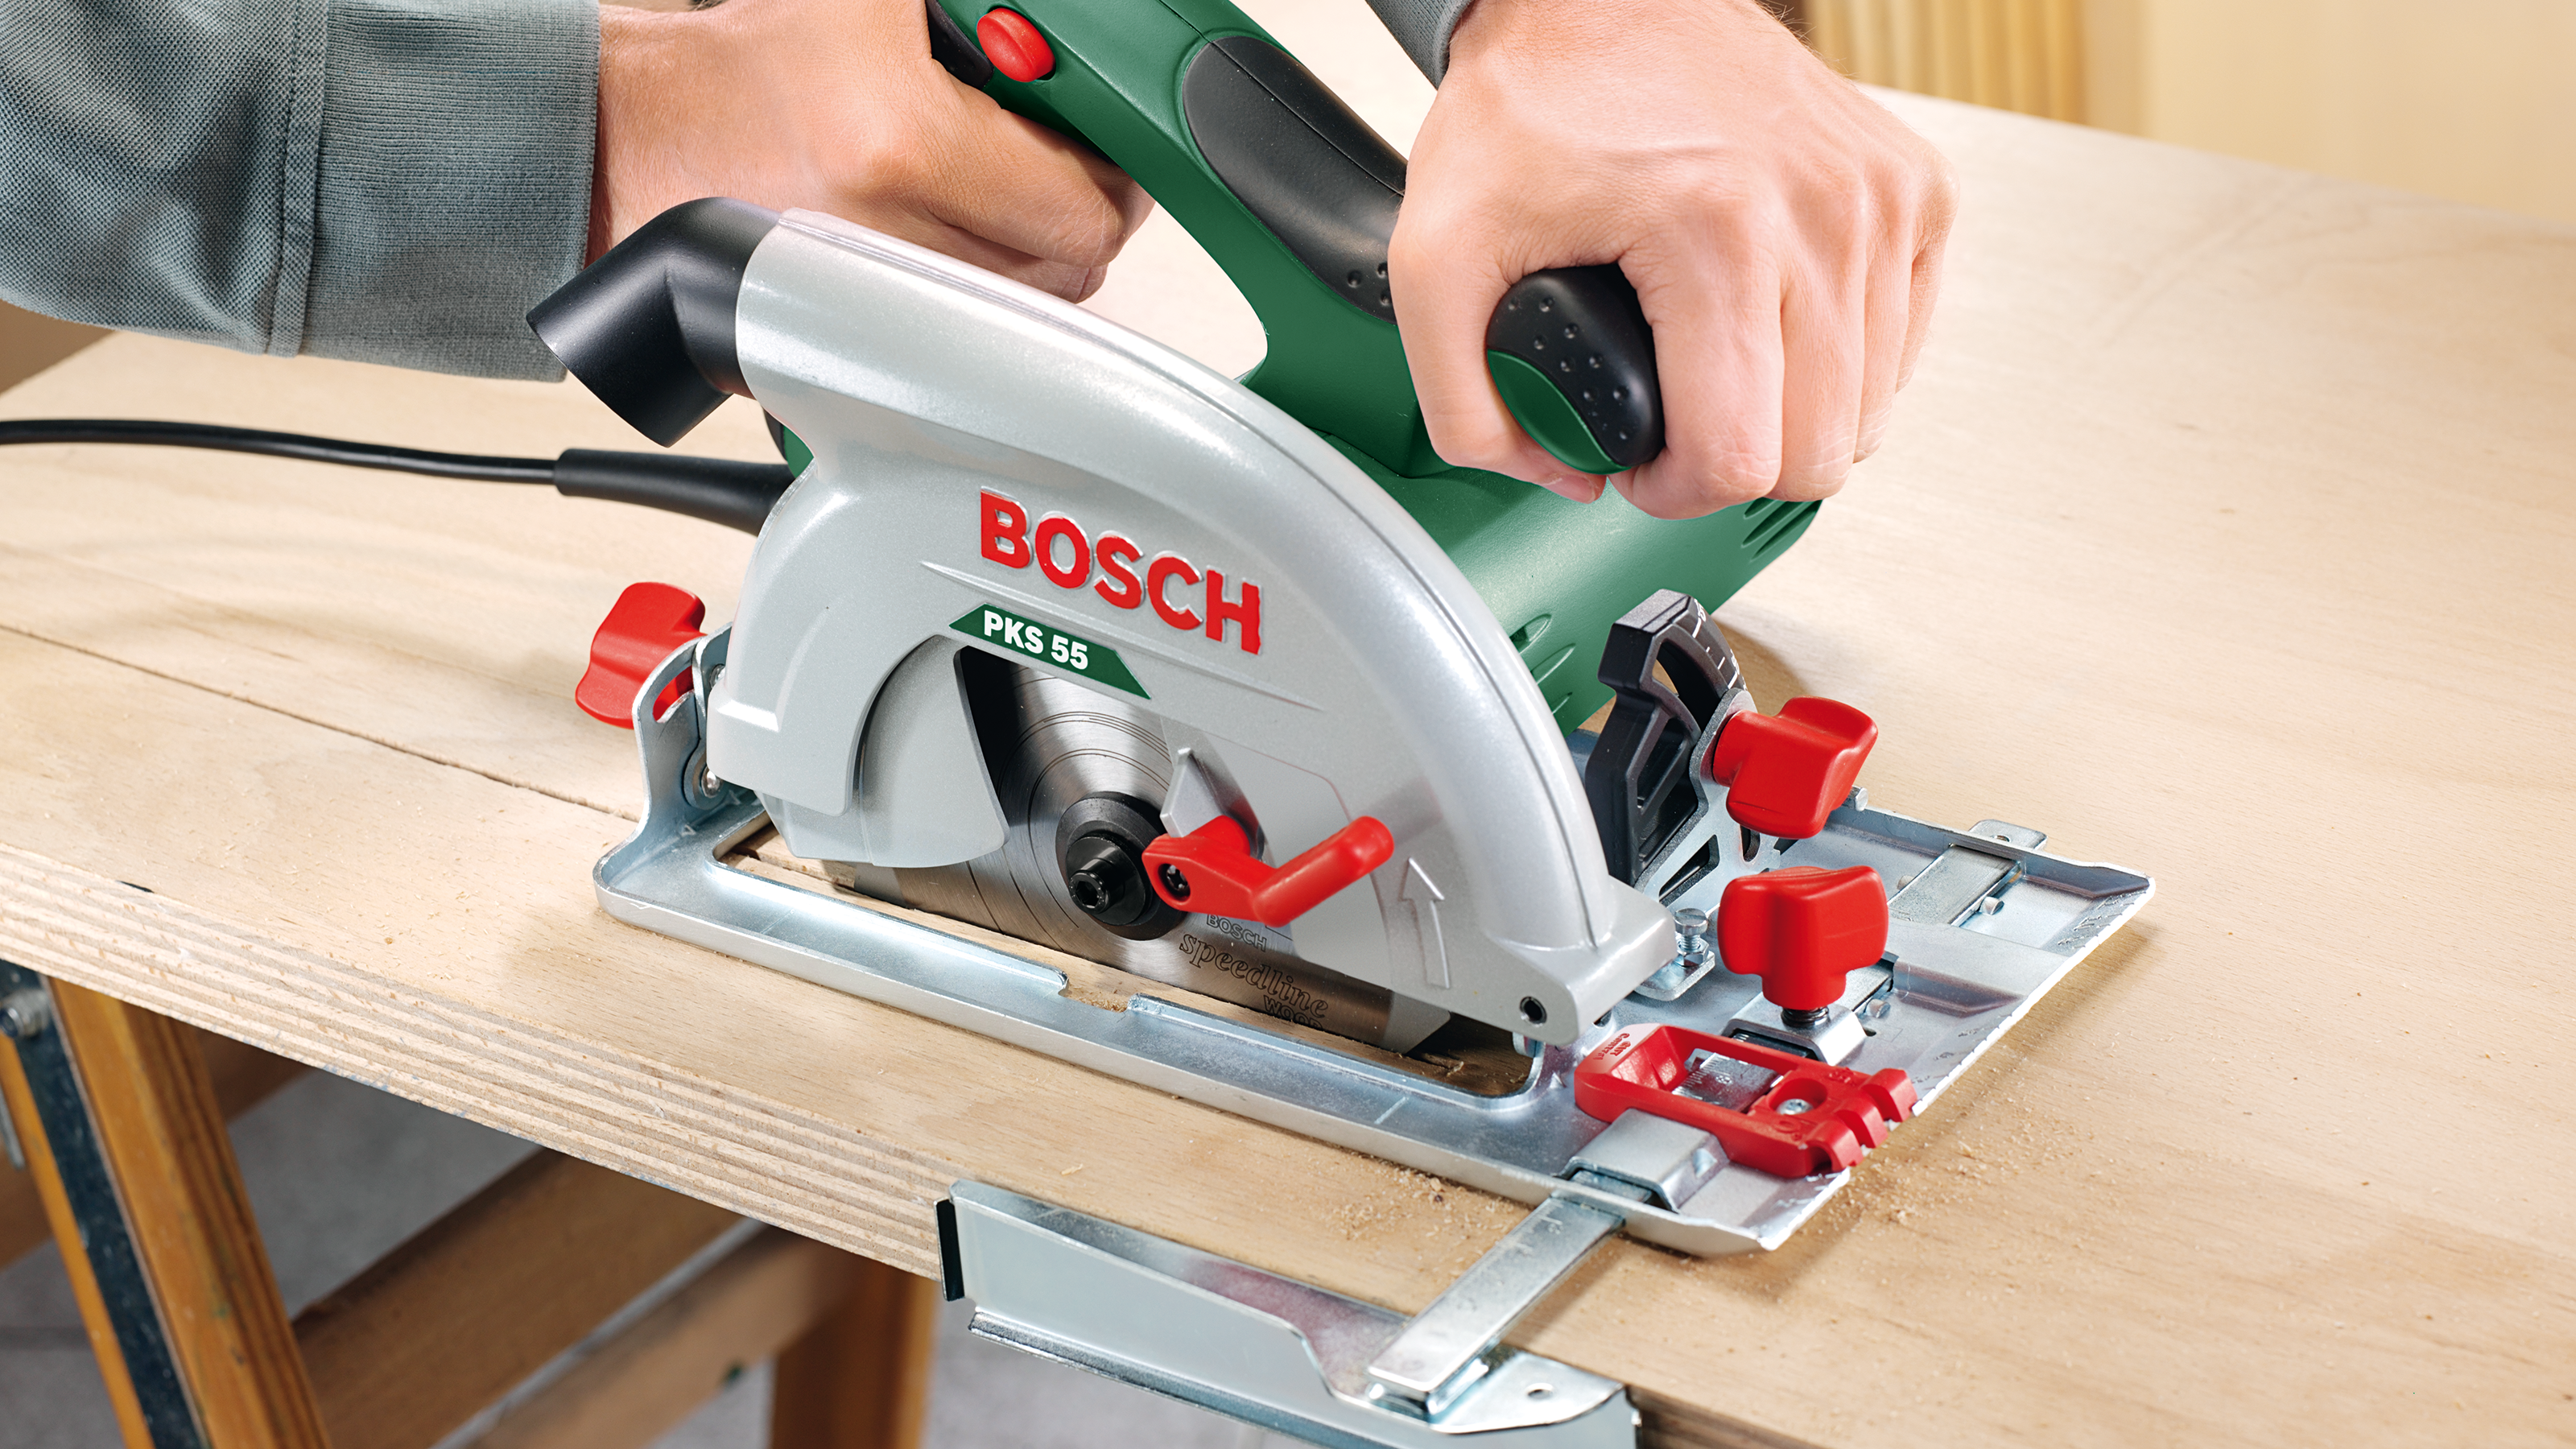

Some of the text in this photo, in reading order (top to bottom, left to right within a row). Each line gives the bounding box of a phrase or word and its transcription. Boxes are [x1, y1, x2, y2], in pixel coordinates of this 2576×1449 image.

[980, 486, 1262, 654] BOSCH
[984, 609, 1088, 670] PKS 55
[1207, 914, 1267, 952] BOSCH
[1179, 934, 1329, 1018] speedline
